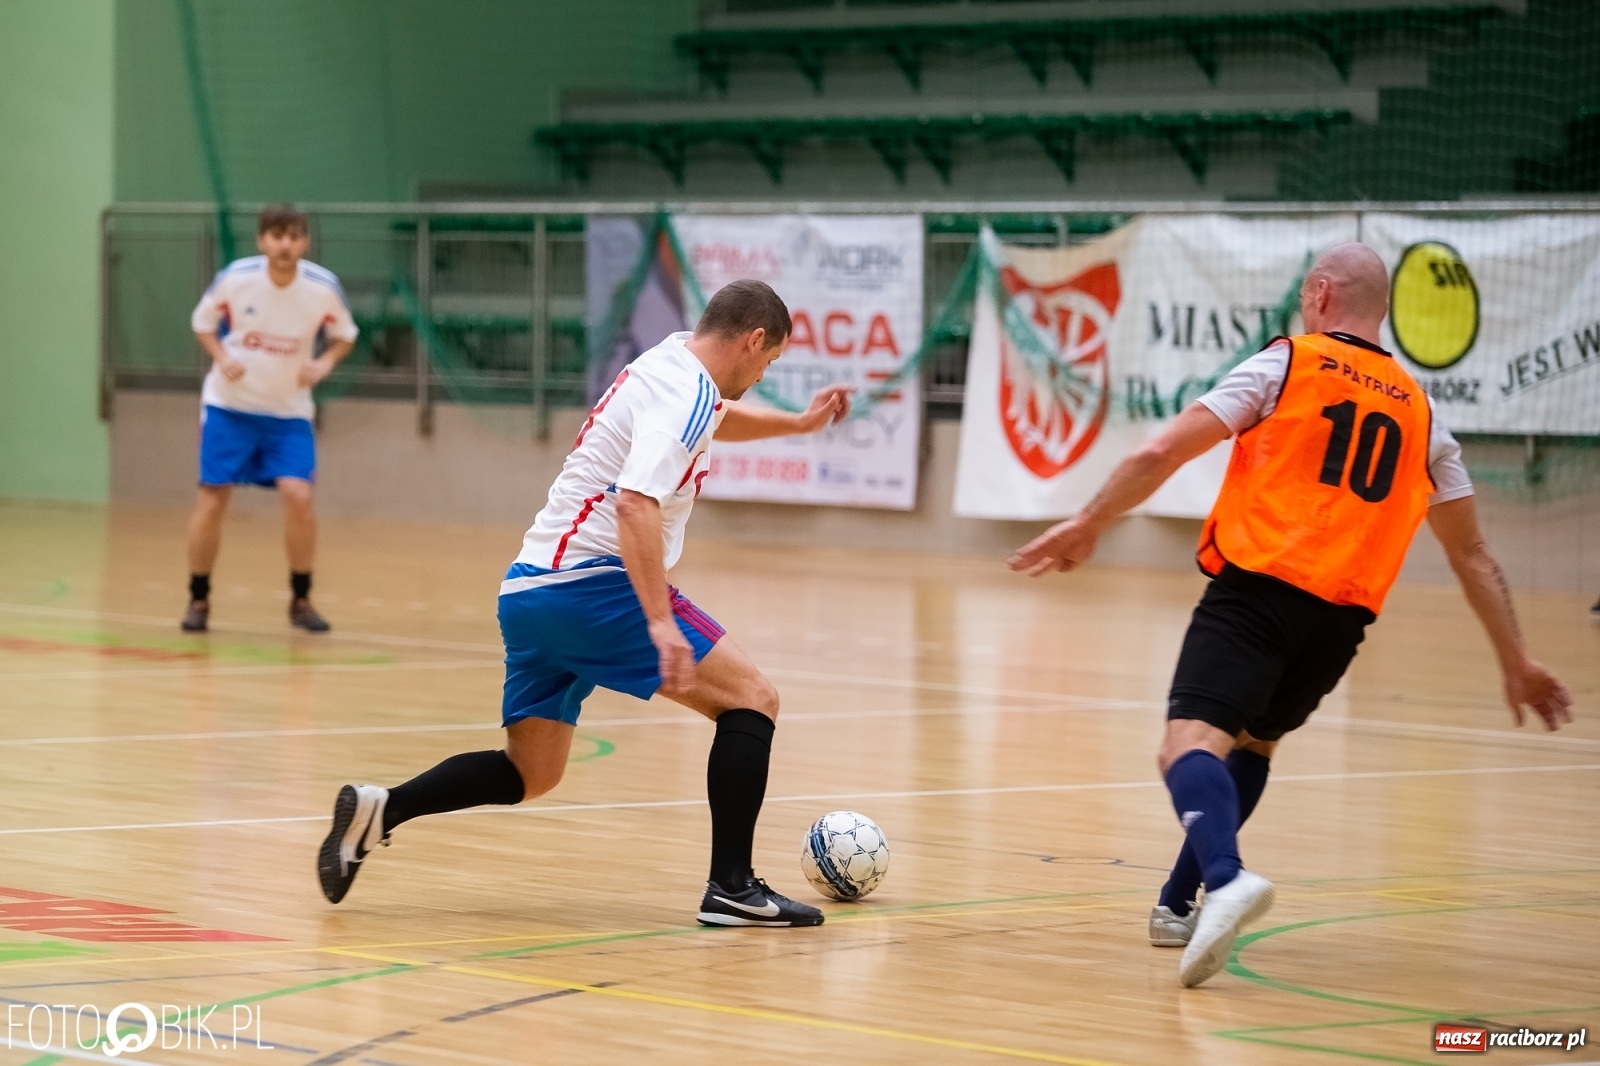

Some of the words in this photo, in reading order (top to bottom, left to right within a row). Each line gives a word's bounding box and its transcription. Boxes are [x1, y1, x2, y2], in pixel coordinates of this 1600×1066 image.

[784, 308, 901, 359] ACA
[1343, 364, 1410, 406] PATRICK
[1500, 337, 1565, 396] JEST
[1318, 399, 1402, 503] 10
